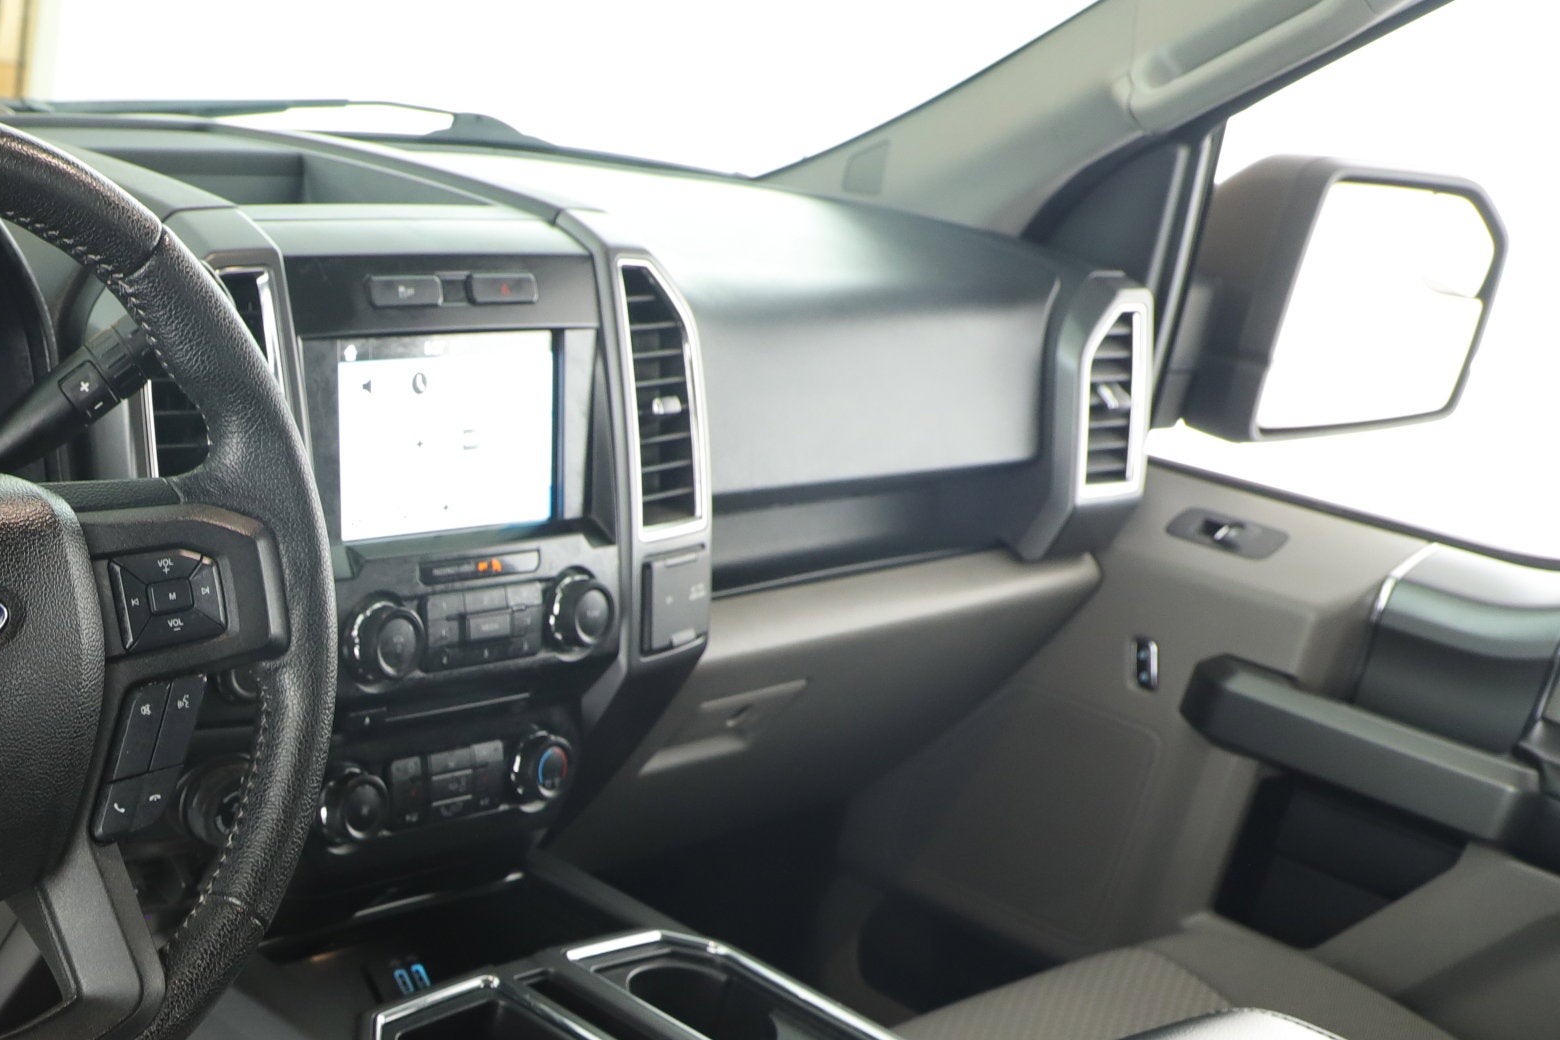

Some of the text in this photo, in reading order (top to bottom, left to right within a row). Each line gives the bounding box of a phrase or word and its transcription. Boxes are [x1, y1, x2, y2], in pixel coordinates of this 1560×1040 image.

[157, 558, 174, 568] VOL
[168, 592, 177, 600] M
[167, 618, 184, 628] VOL
